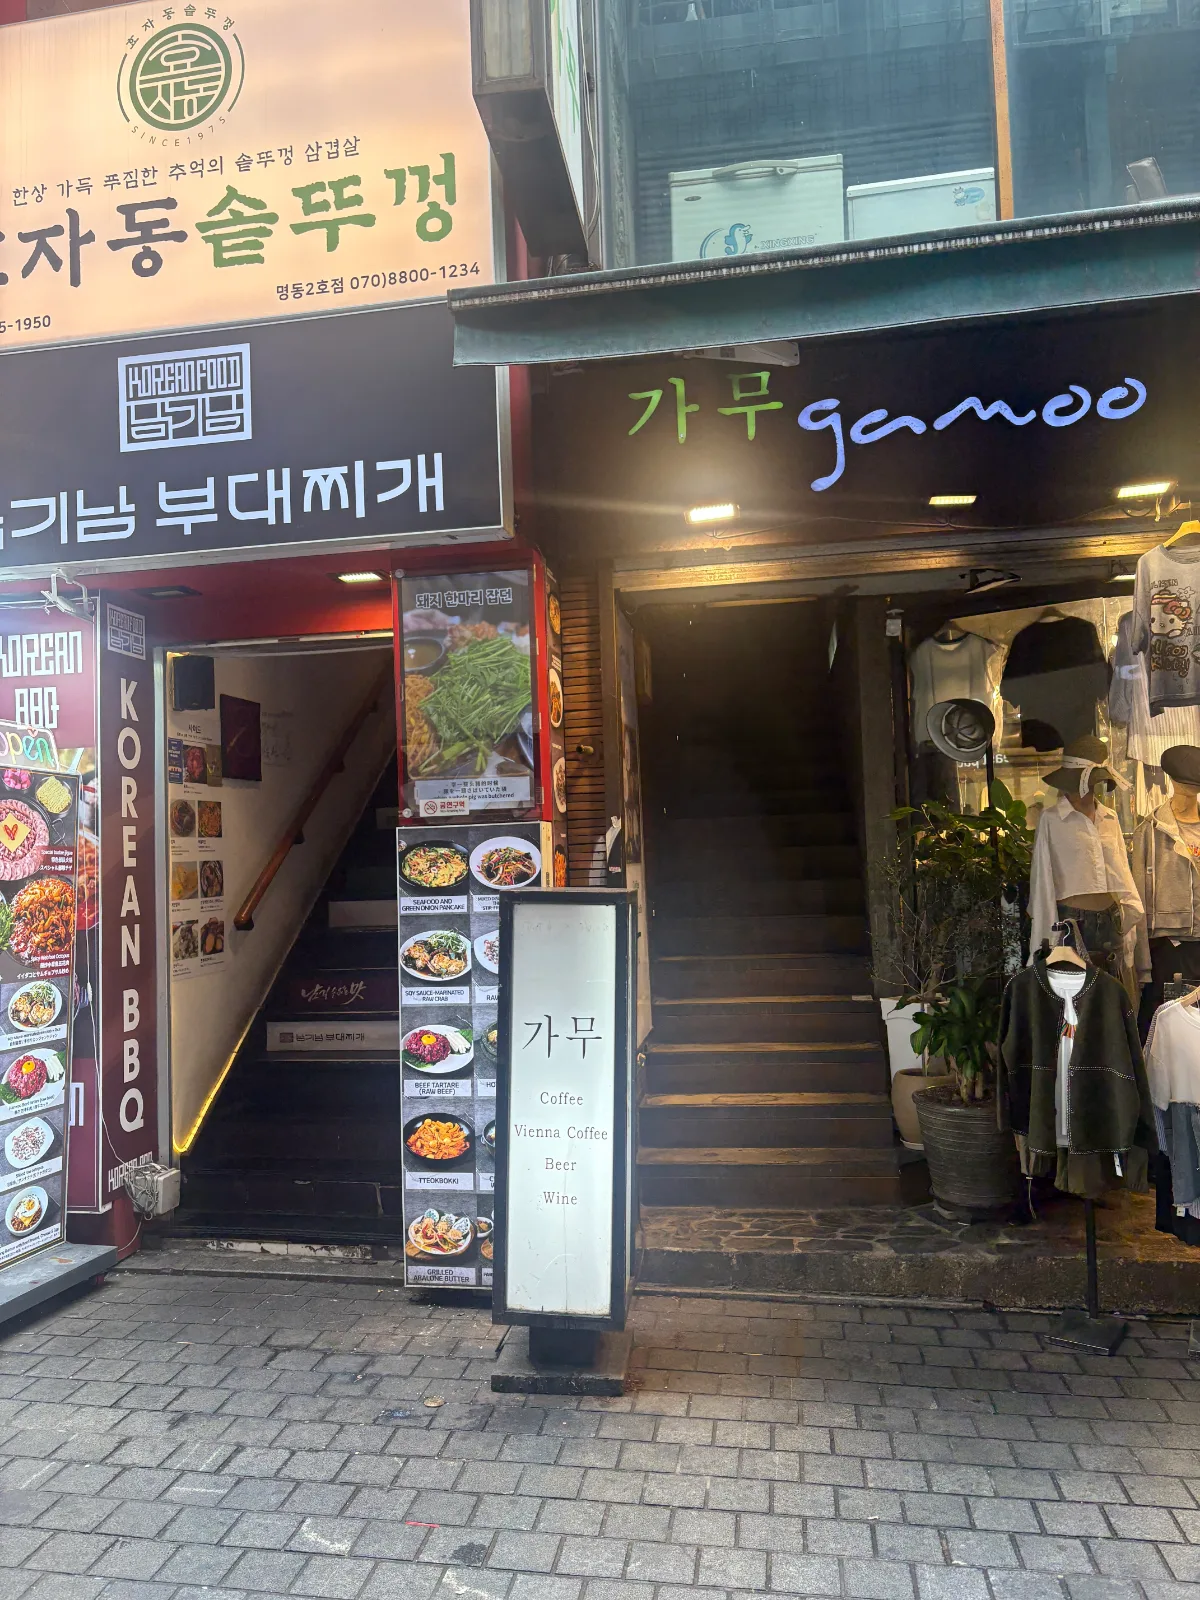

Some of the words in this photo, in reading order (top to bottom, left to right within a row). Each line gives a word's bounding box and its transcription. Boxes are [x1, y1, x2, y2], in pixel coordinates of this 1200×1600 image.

[12, 183, 47, 207] 한상
[57, 177, 93, 199] 가득
[103, 166, 158, 191] 푸짐한
[168, 155, 224, 181] 추억의
[234, 145, 294, 173] 솥뚜껑
[304, 136, 361, 162] 삼겹살
[0, 152, 457, 288] 자동솥뚜껑
[760, 234, 815, 249] XINGXING
[276, 276, 345, 301] 명동2호점
[350, 261, 481, 290] 070)8800-1234
[797, 377, 1148, 491] gamoo
[0, 486, 136, 549] 기남
[156, 452, 445, 535] 부대찌개
[416, 592, 443, 609] 돼지
[444, 590, 484, 607] 한마리
[485, 587, 513, 604] 잡던
[117, 677, 145, 967] KOREAN
[522, 1014, 602, 1059] 가무
[119, 988, 144, 1132] BBQ
[540, 1091, 584, 1106] Coffee
[514, 1124, 561, 1139] Vienna
[567, 1126, 608, 1141] Coffee
[545, 1157, 577, 1172] Beer
[543, 1191, 578, 1206] Wine
[427, 1268, 454, 1276] GRILLED
[444, 1275, 470, 1283] BUTTER
